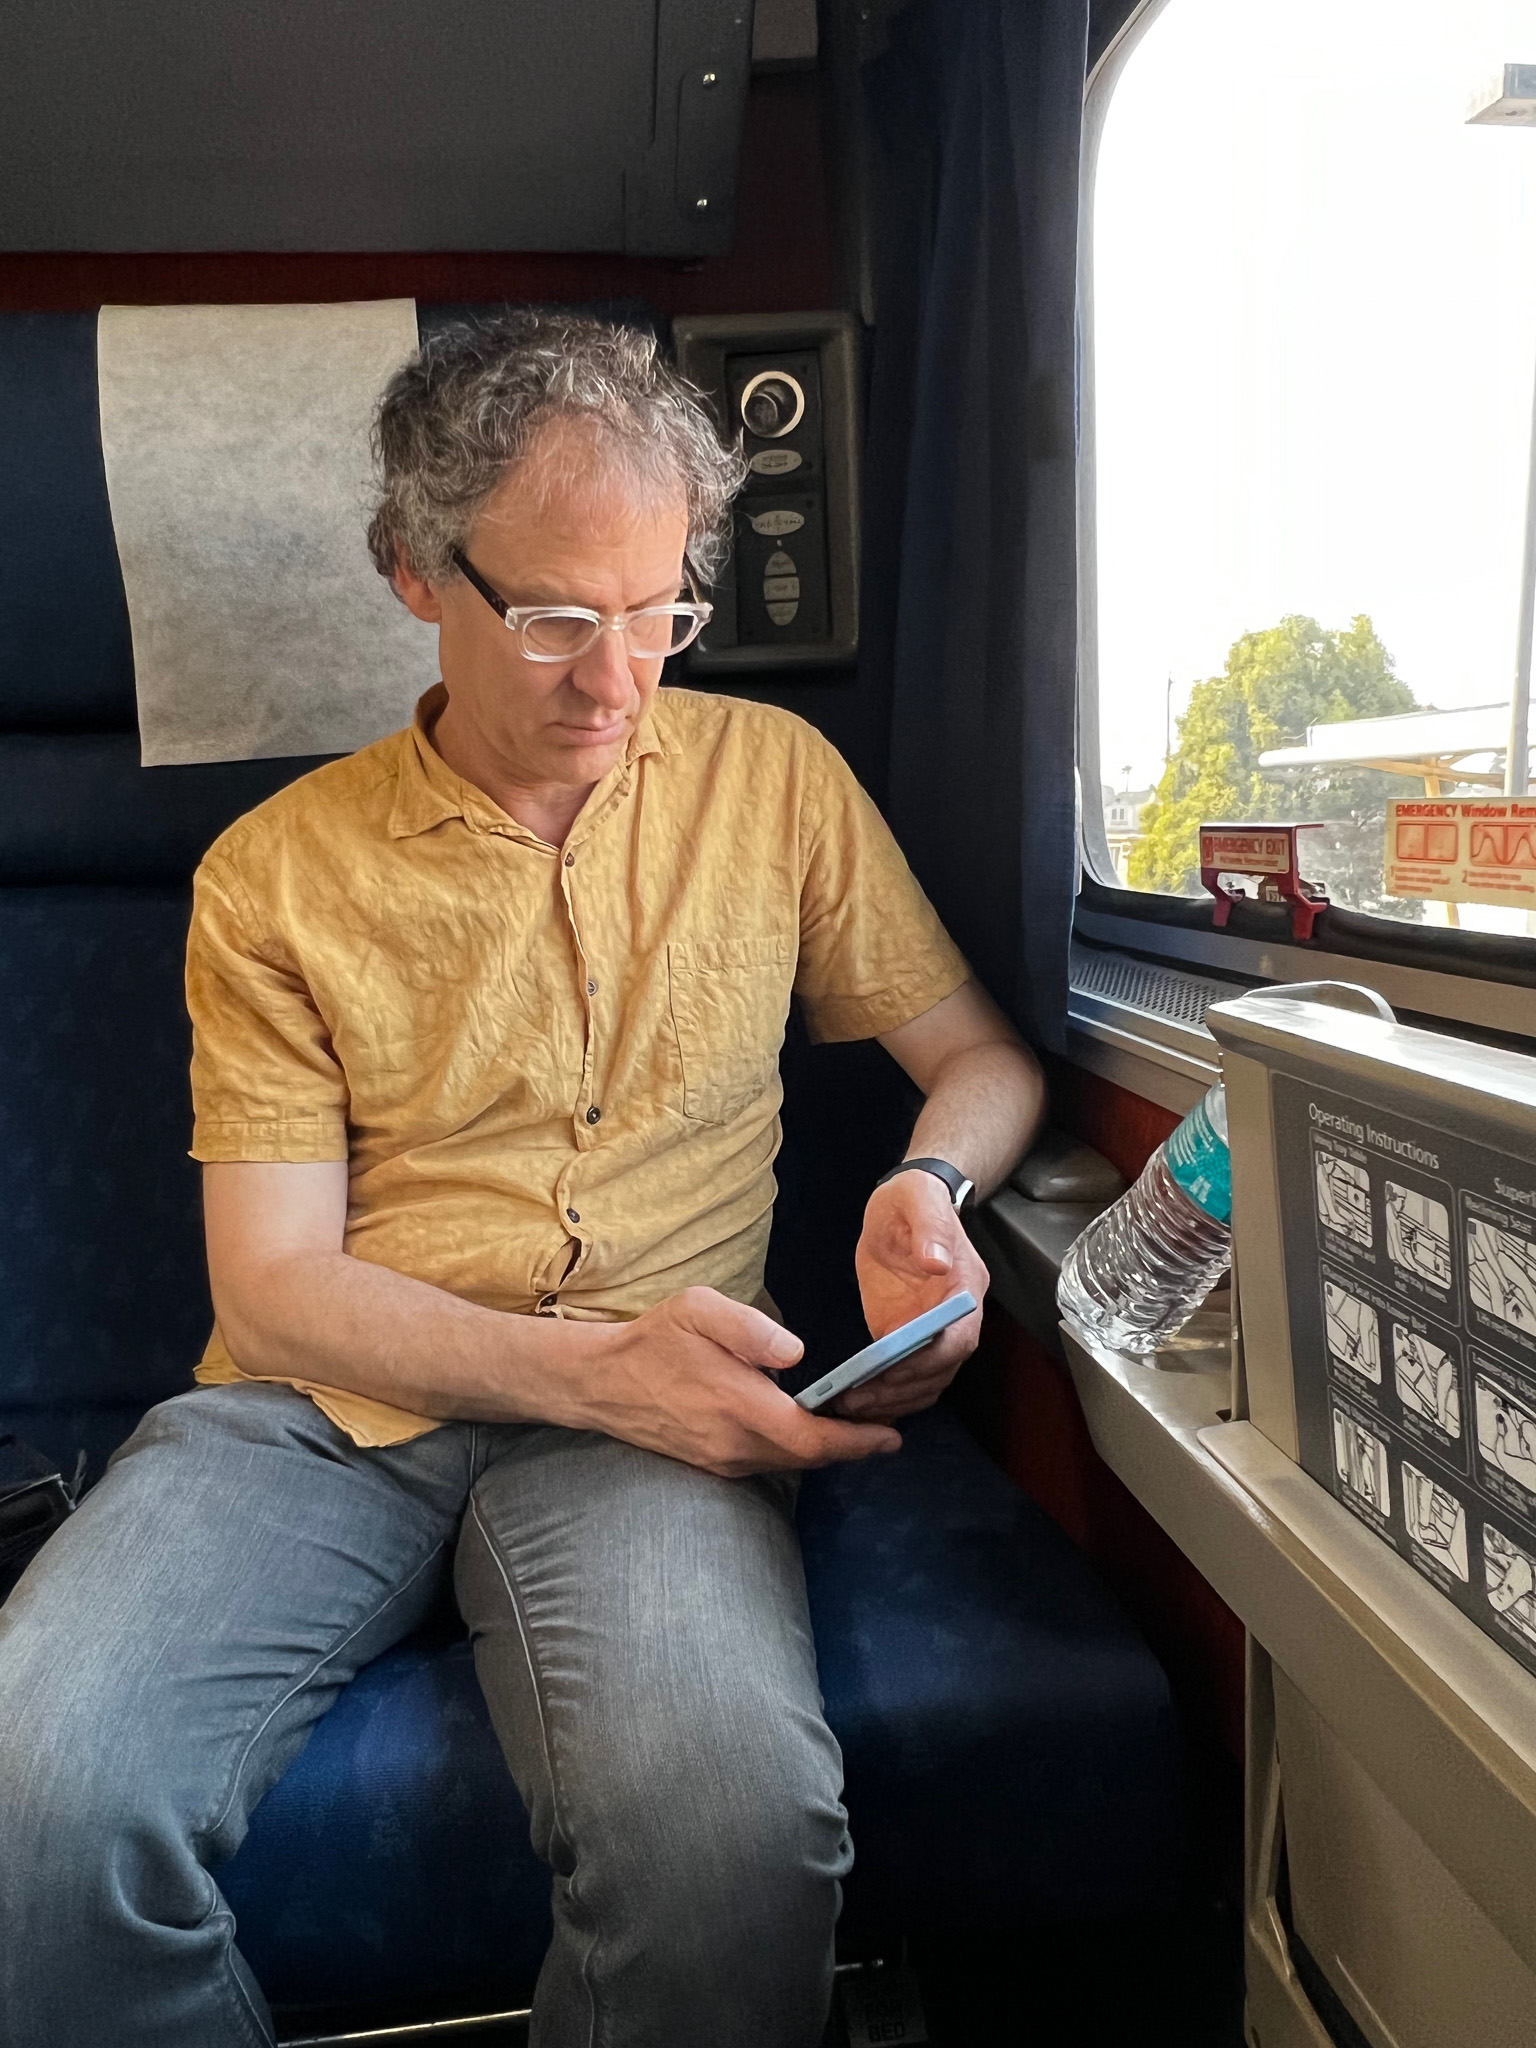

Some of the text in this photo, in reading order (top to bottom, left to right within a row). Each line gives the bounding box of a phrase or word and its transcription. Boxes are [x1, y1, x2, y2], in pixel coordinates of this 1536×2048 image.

[1396, 804, 1457, 818] EMERGENCY
[1461, 803, 1507, 818] Window
[1213, 836, 1285, 856] EMERGENCY EXIT
[1309, 1102, 1440, 1170] Operating Instructions
